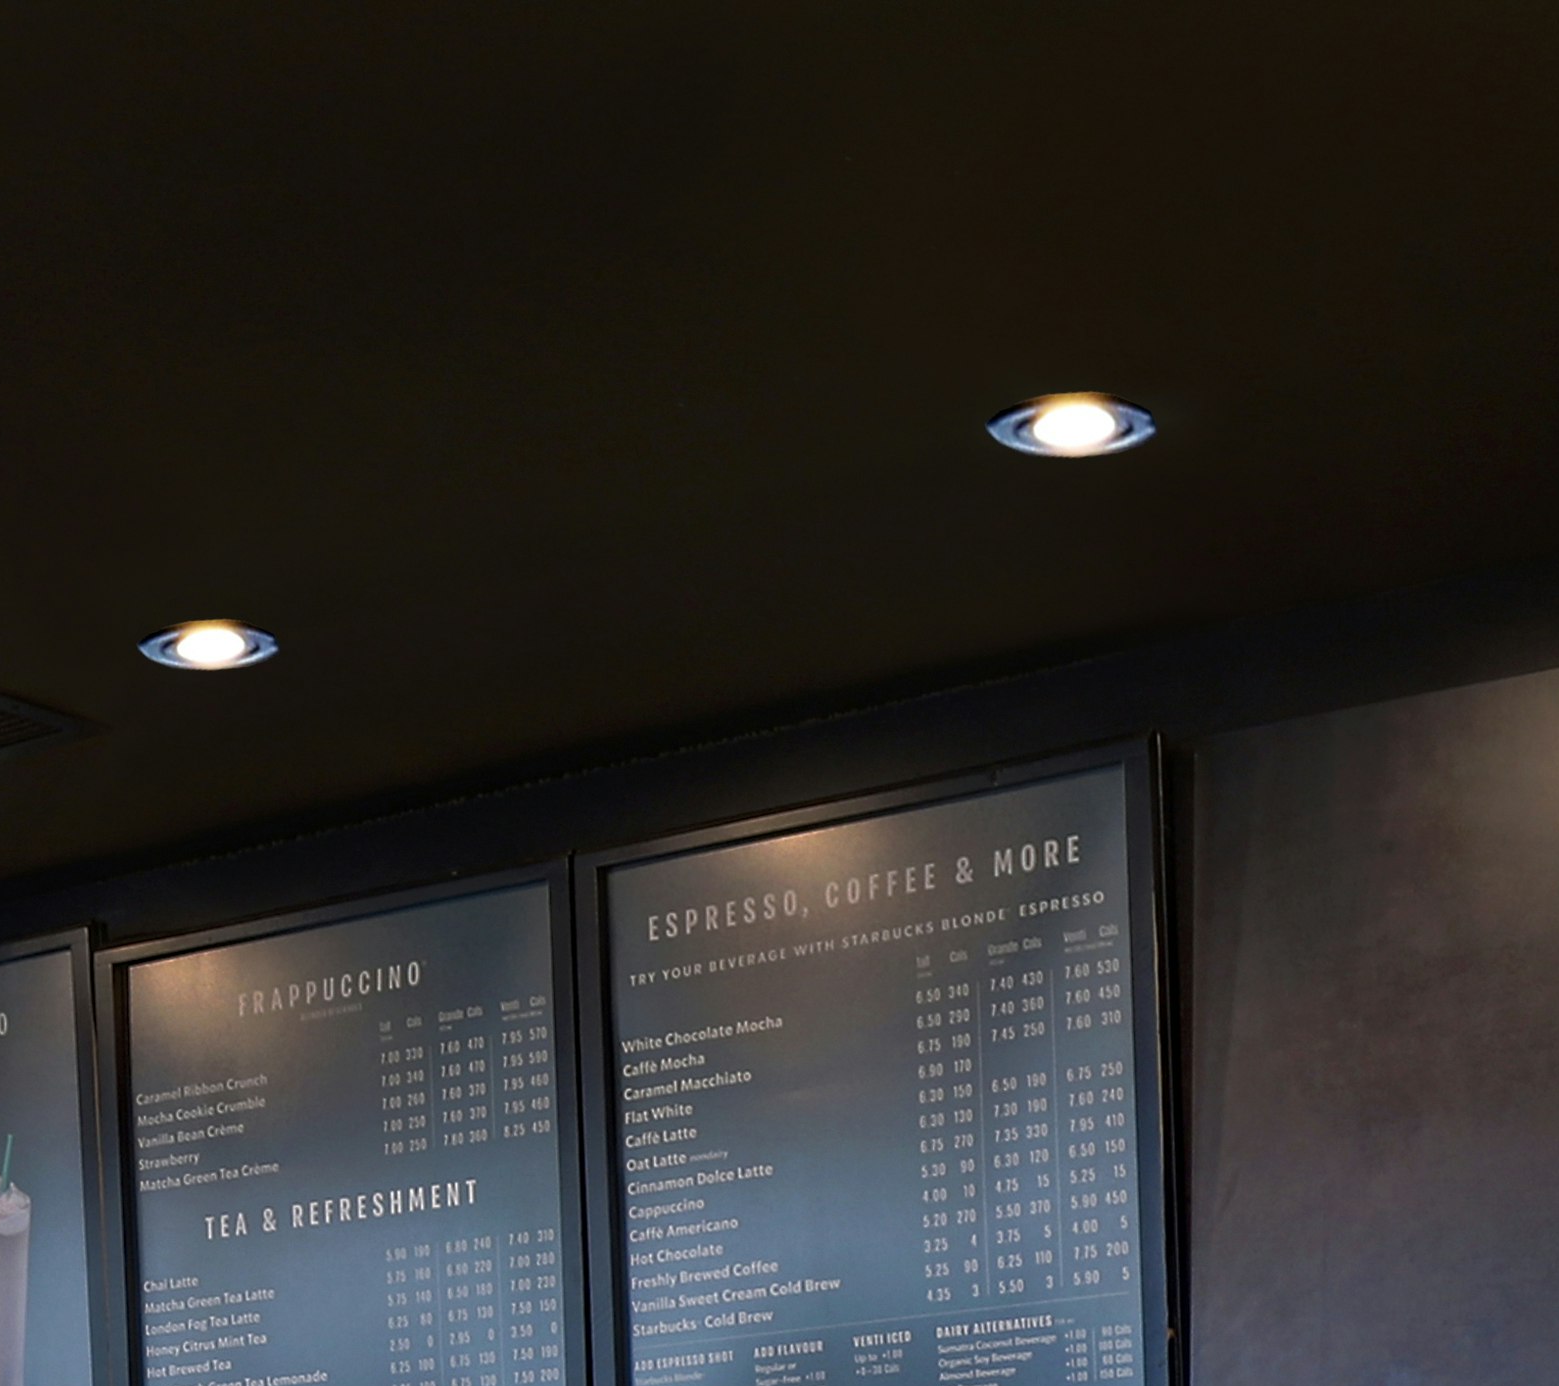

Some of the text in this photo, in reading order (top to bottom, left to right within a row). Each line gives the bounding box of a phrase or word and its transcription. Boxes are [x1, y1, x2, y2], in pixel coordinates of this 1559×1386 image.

[648, 834, 1081, 941] ESPRESSO, COFFEE & MORE
[238, 961, 422, 1018] FRAPPUCCINO
[622, 1016, 783, 1054] White Chocolate Mocha
[136, 1074, 268, 1106] Caramel Ribbon Crunch
[624, 1070, 752, 1102] Caramel Macchiato
[138, 1151, 200, 1171] Strawberry
[204, 1179, 478, 1241] TEA & REFRESHMENT
[628, 1198, 705, 1220] Cappuccino
[631, 1259, 779, 1291] Freshly Brewed Coffee
[146, 1332, 267, 1359] Honey Citrus Mint Tea
